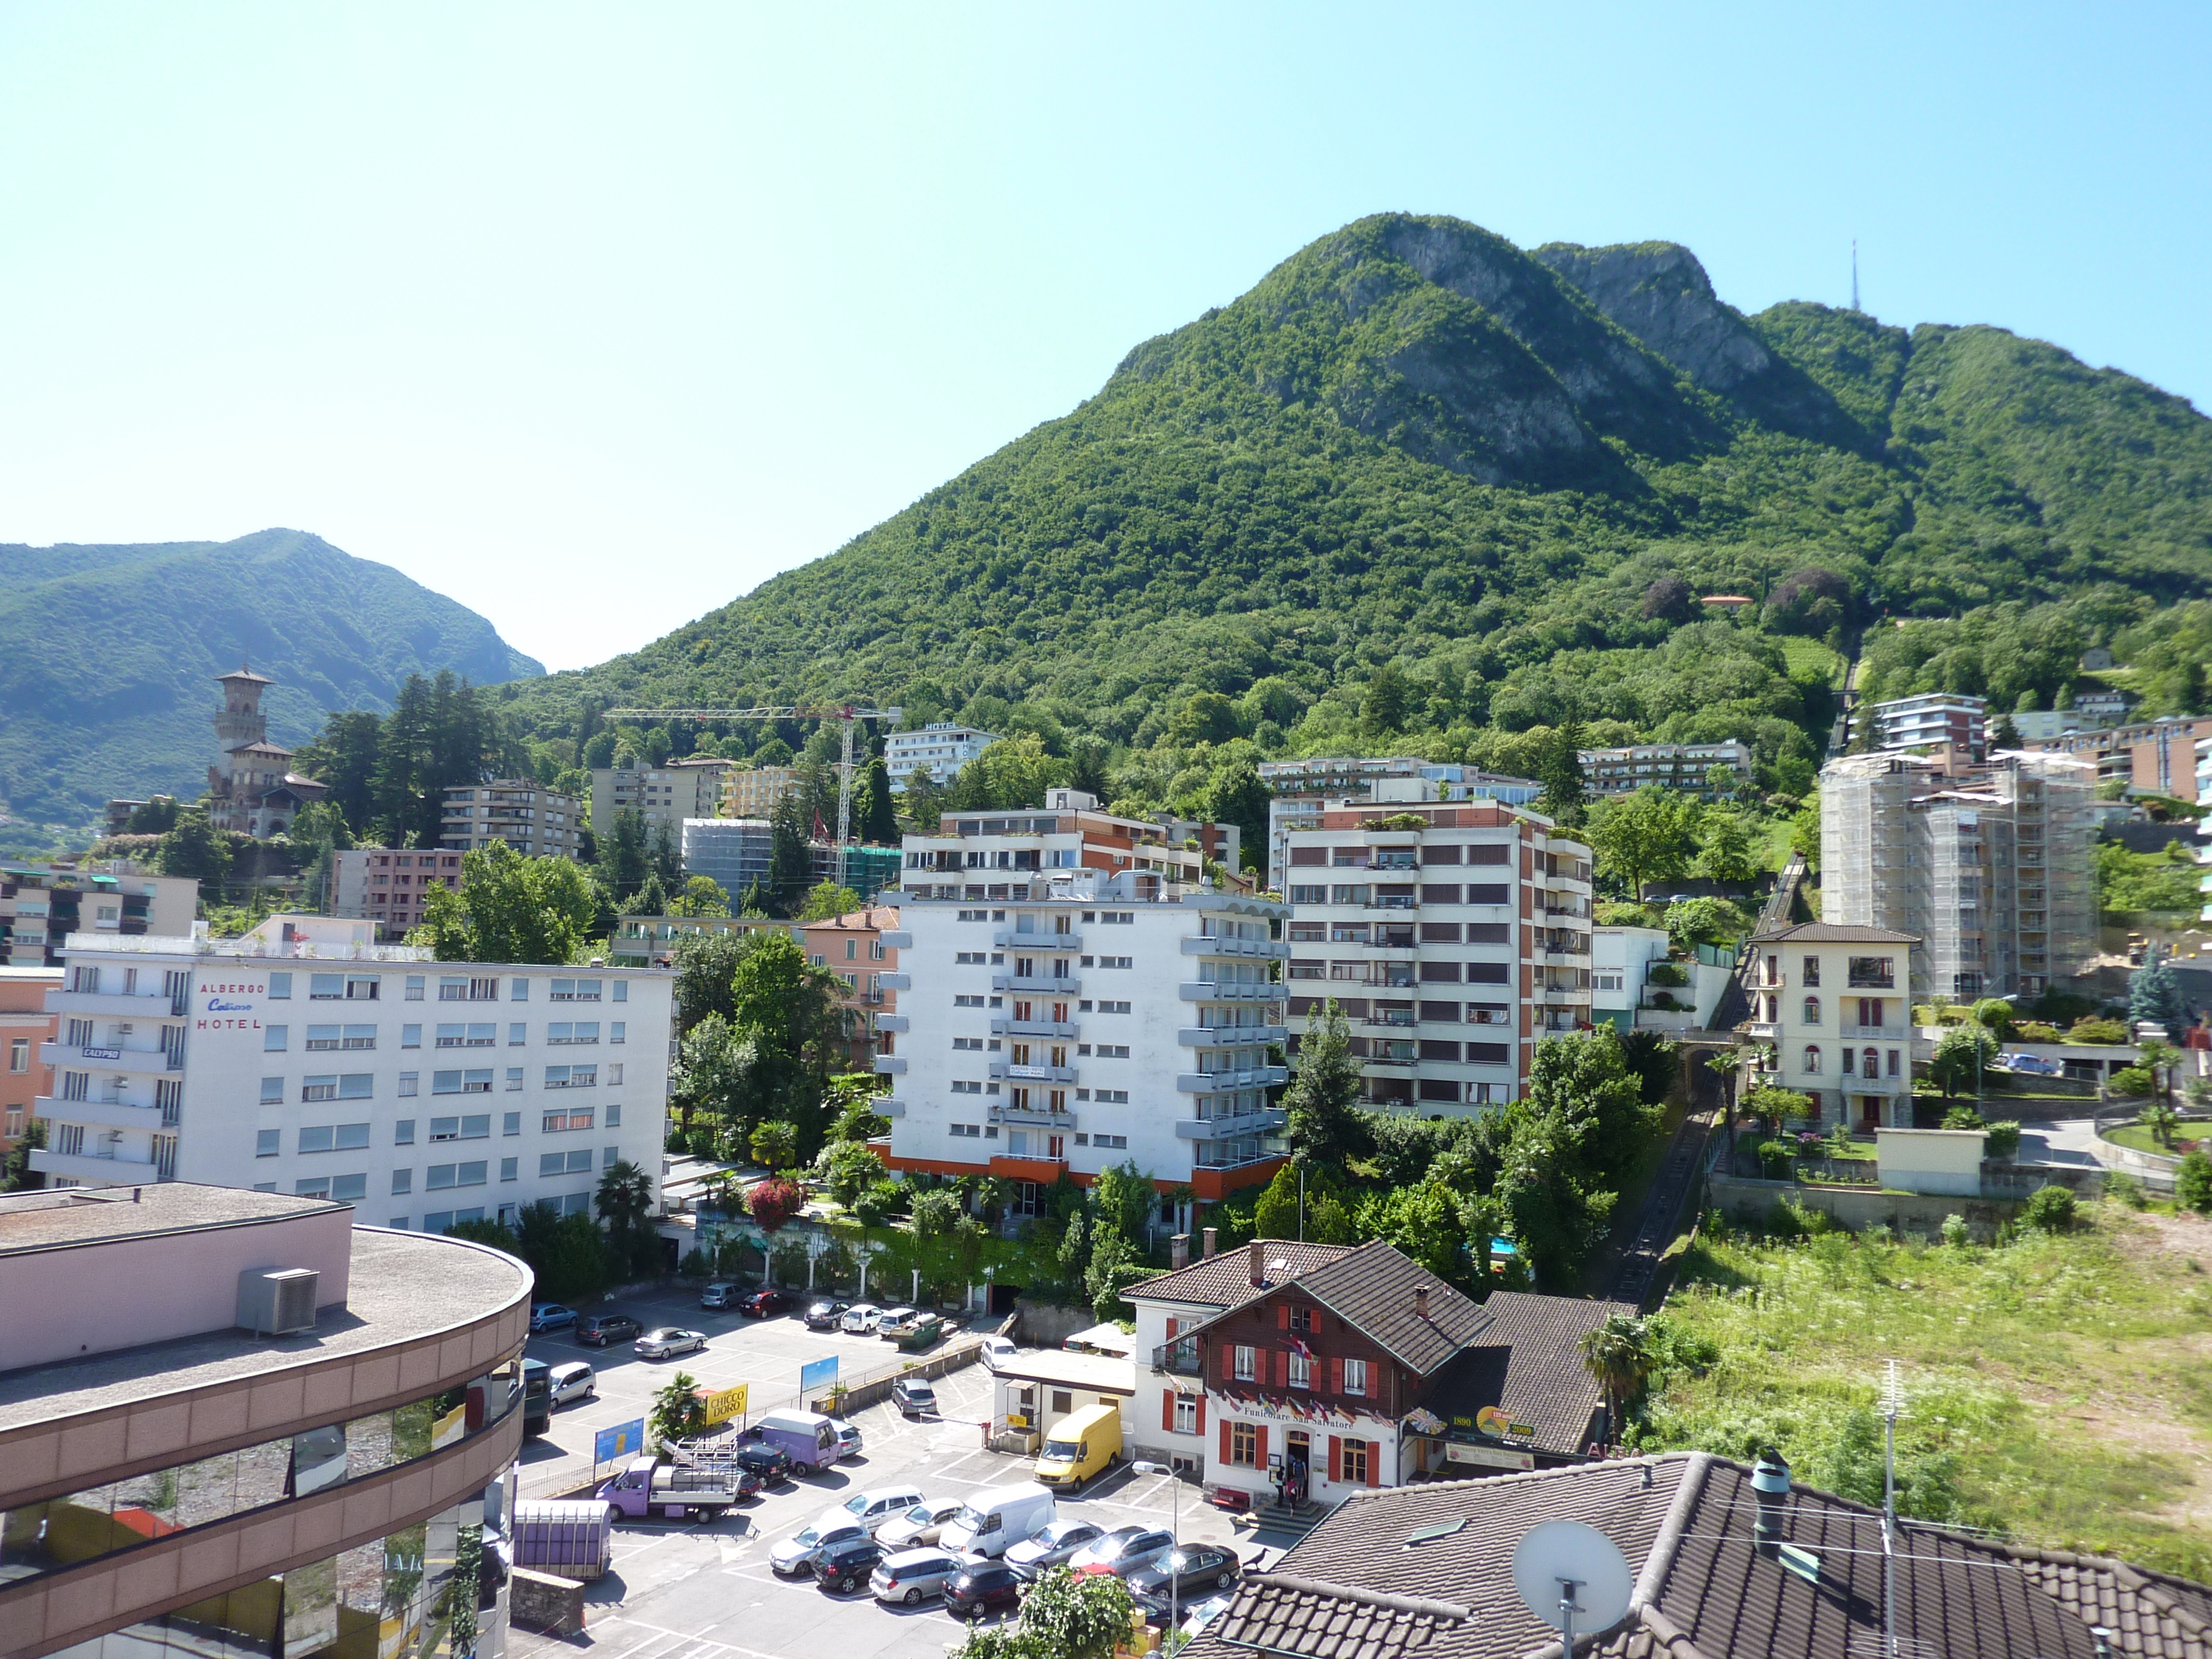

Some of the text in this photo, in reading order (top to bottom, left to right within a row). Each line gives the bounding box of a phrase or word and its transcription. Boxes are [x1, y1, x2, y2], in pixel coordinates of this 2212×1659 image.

[926, 722, 956, 731] HOTEL
[200, 984, 264, 993] ALBERGO
[197, 1019, 261, 1030] HOTEL
[84, 1048, 119, 1059] CALYPSO
[711, 1390, 745, 1409] CHICCO
[1245, 1407, 1290, 1421] Funicolare
[1453, 1416, 1471, 1427] 1890
[1512, 1425, 1532, 1435] 2009
